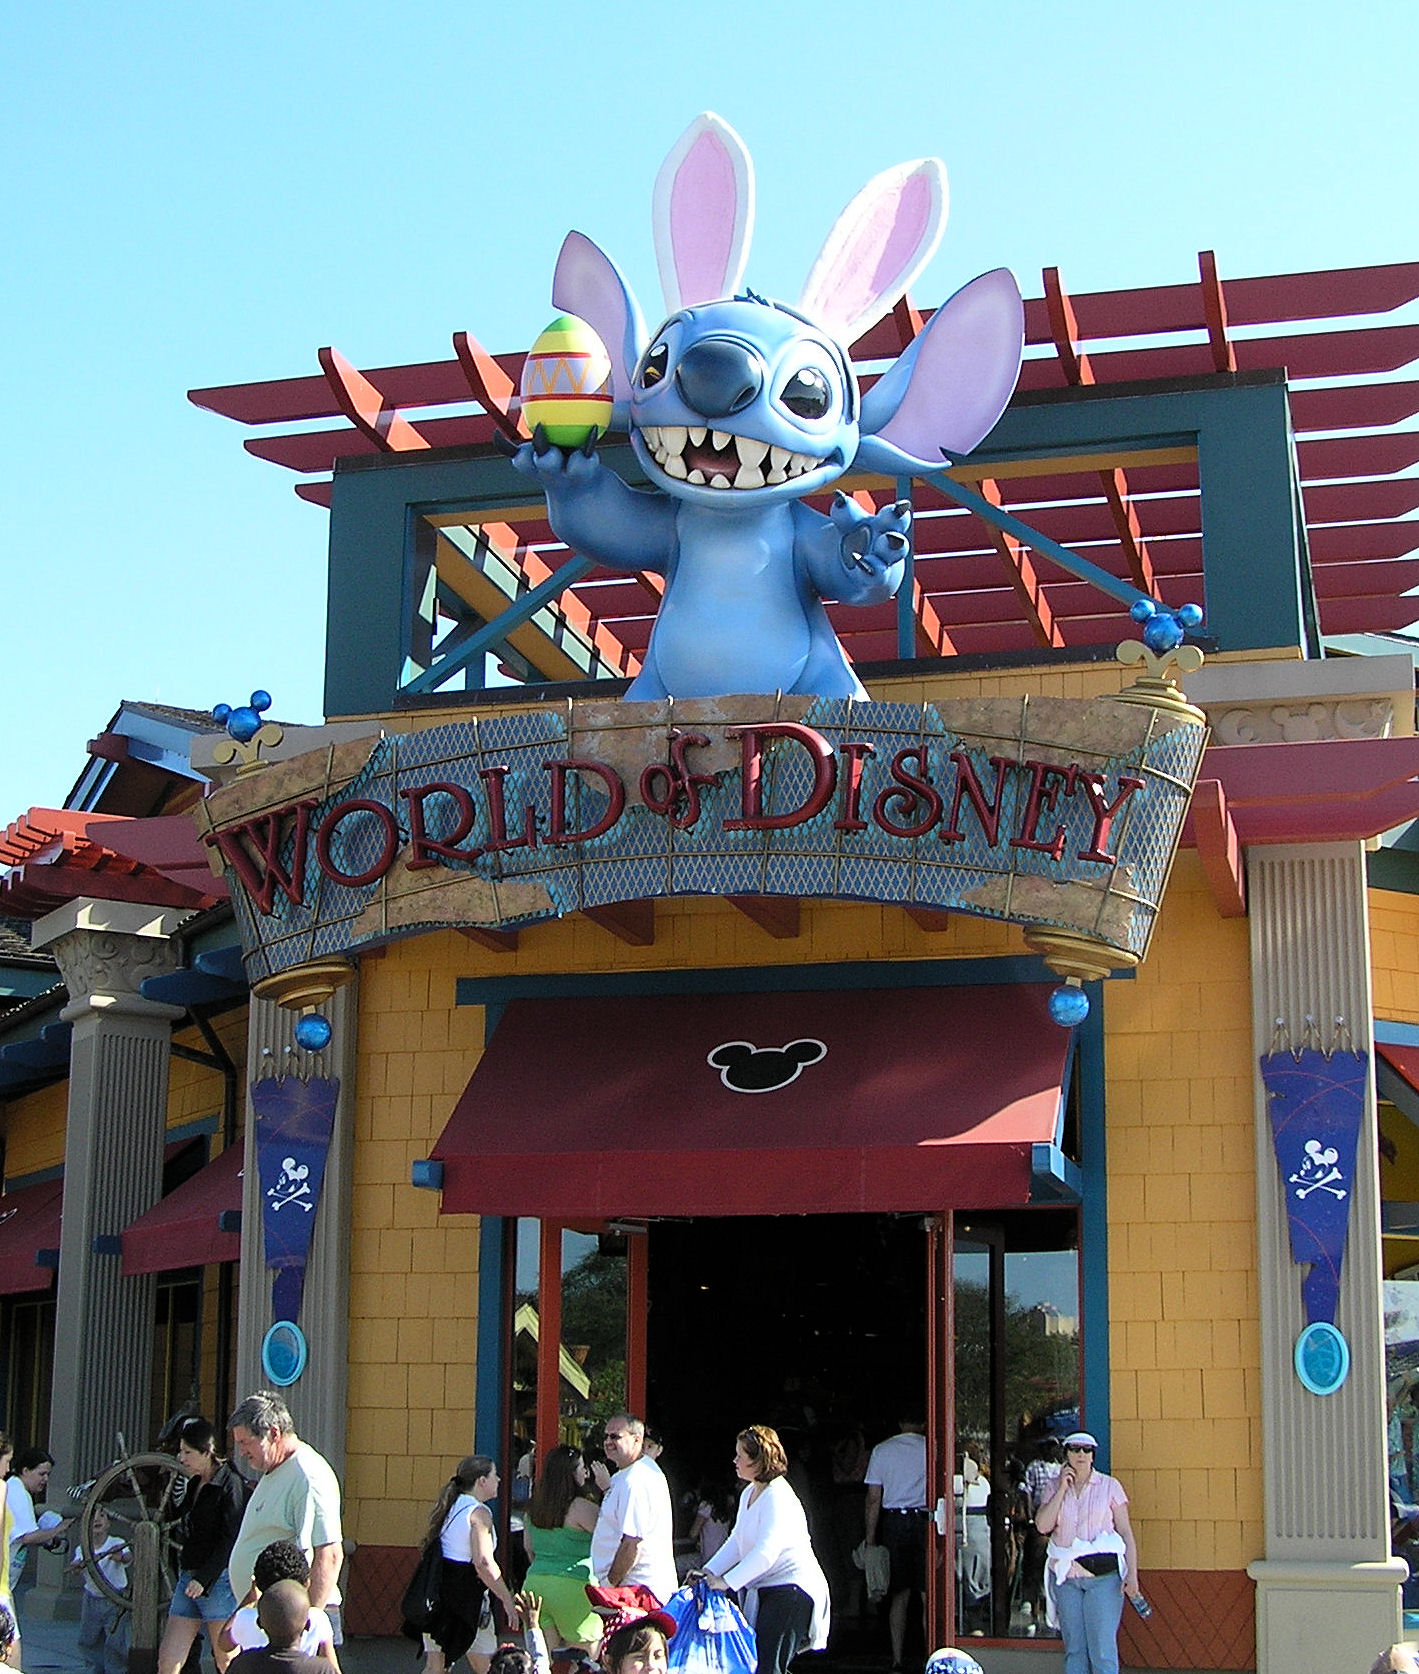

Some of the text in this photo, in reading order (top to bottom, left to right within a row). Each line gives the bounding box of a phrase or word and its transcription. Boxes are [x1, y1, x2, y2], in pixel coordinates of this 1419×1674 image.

[206, 722, 1146, 915] WORLD of DISNEY
